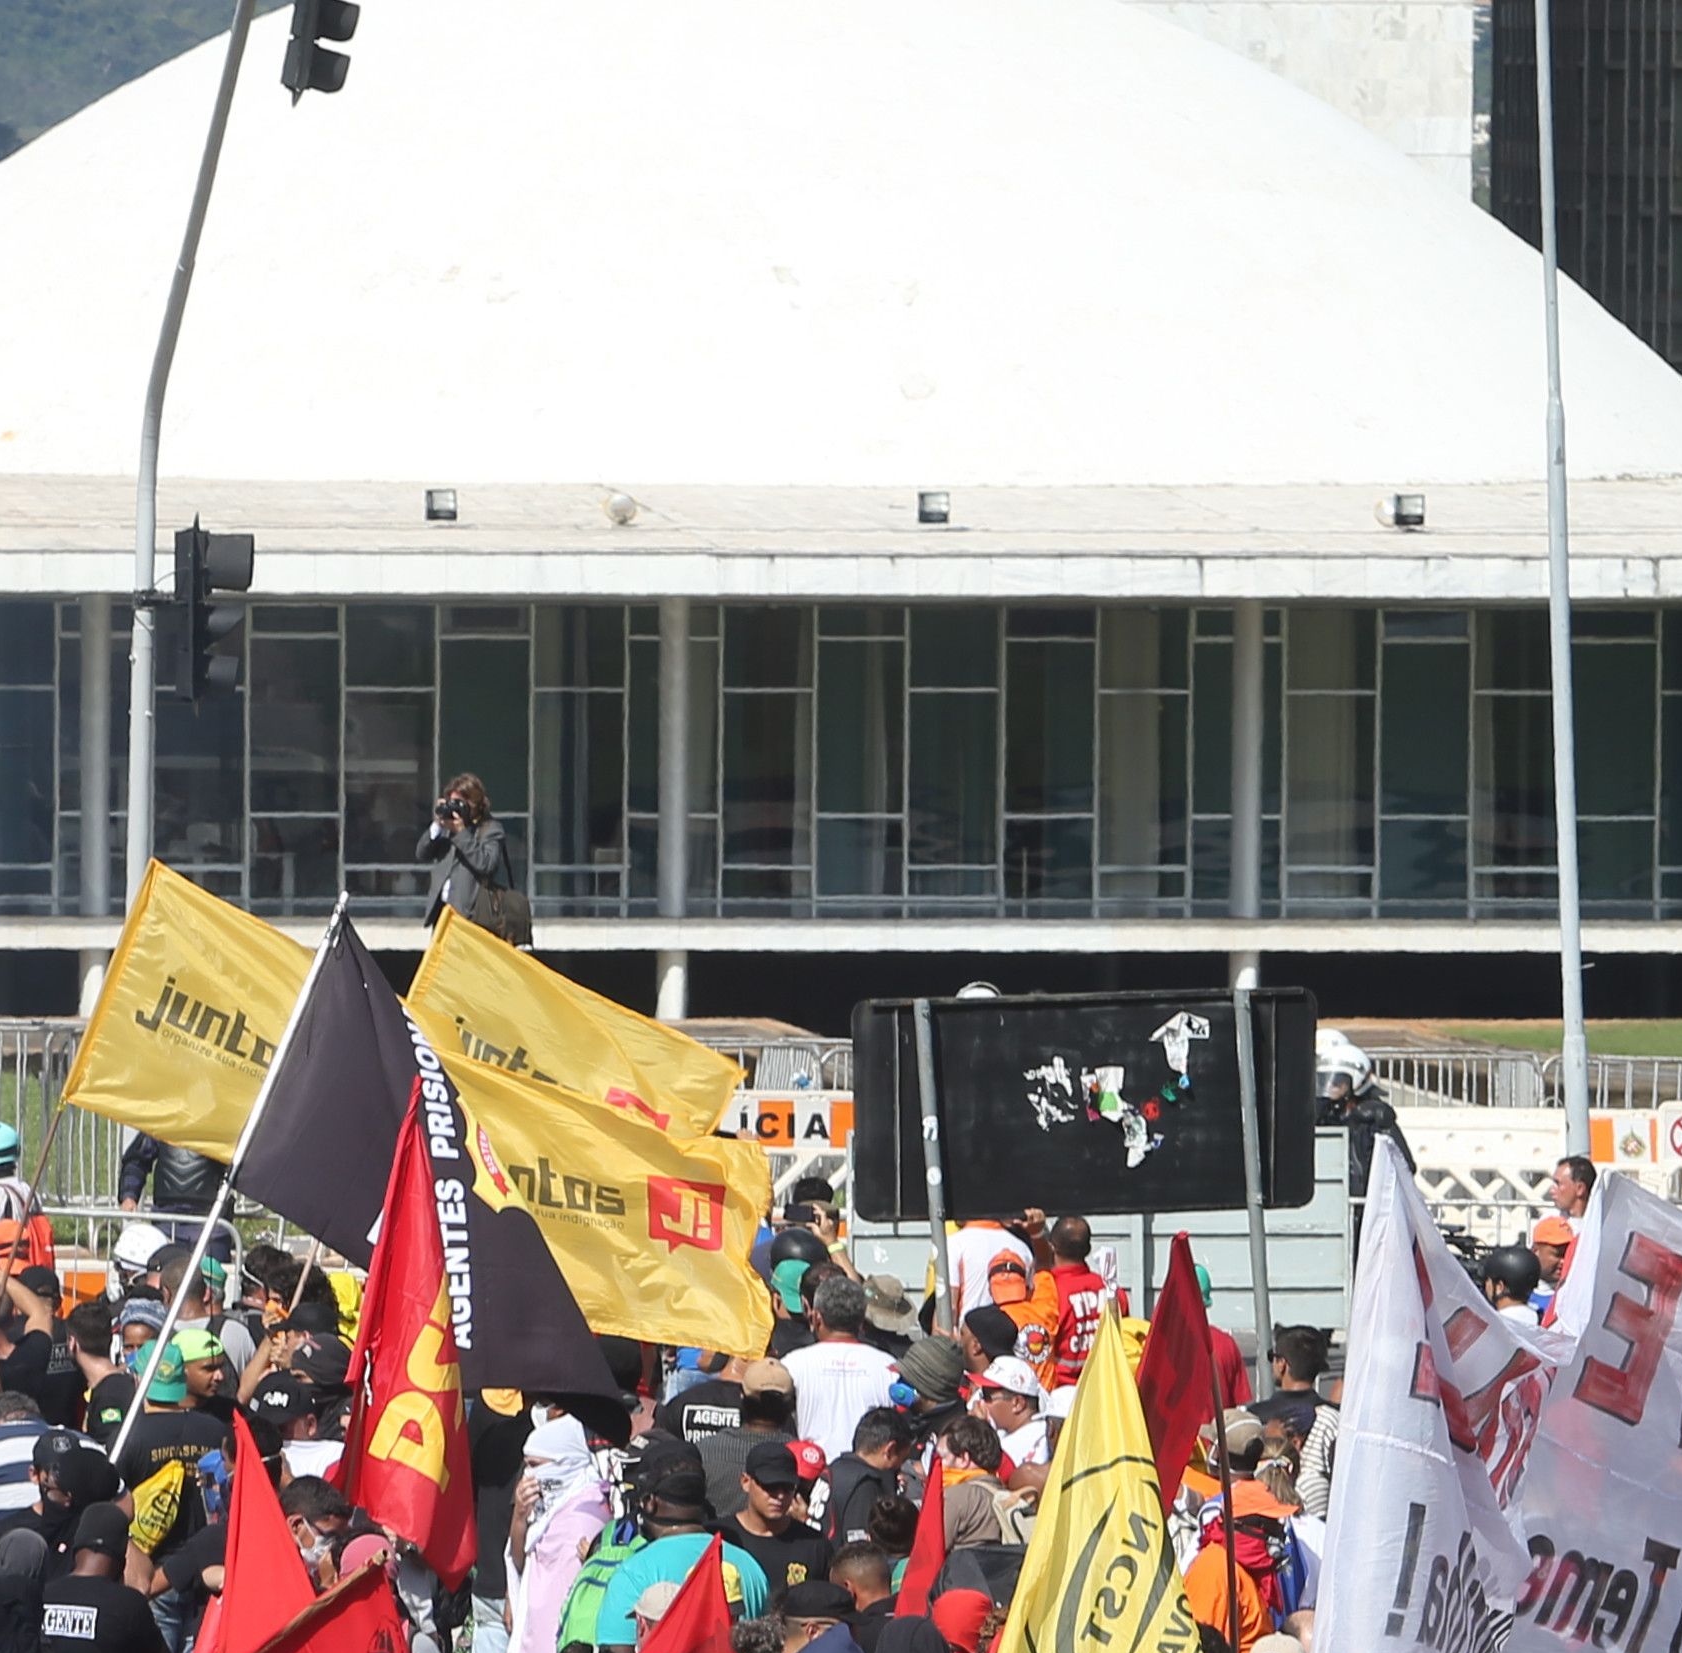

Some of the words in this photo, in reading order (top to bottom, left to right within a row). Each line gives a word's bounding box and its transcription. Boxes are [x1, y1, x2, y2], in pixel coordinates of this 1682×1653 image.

[135, 976, 277, 1068] junto
[161, 1028, 212, 1059] organize
[216, 1051, 236, 1069] sua
[401, 1008, 459, 1159] PRISION
[739, 1105, 830, 1140] ÍCIA
[507, 1157, 626, 1216] ntos
[436, 1178, 472, 1350] AGENTES
[693, 1409, 741, 1428] AGENTE
[42, 1607, 94, 1635] GENTE
